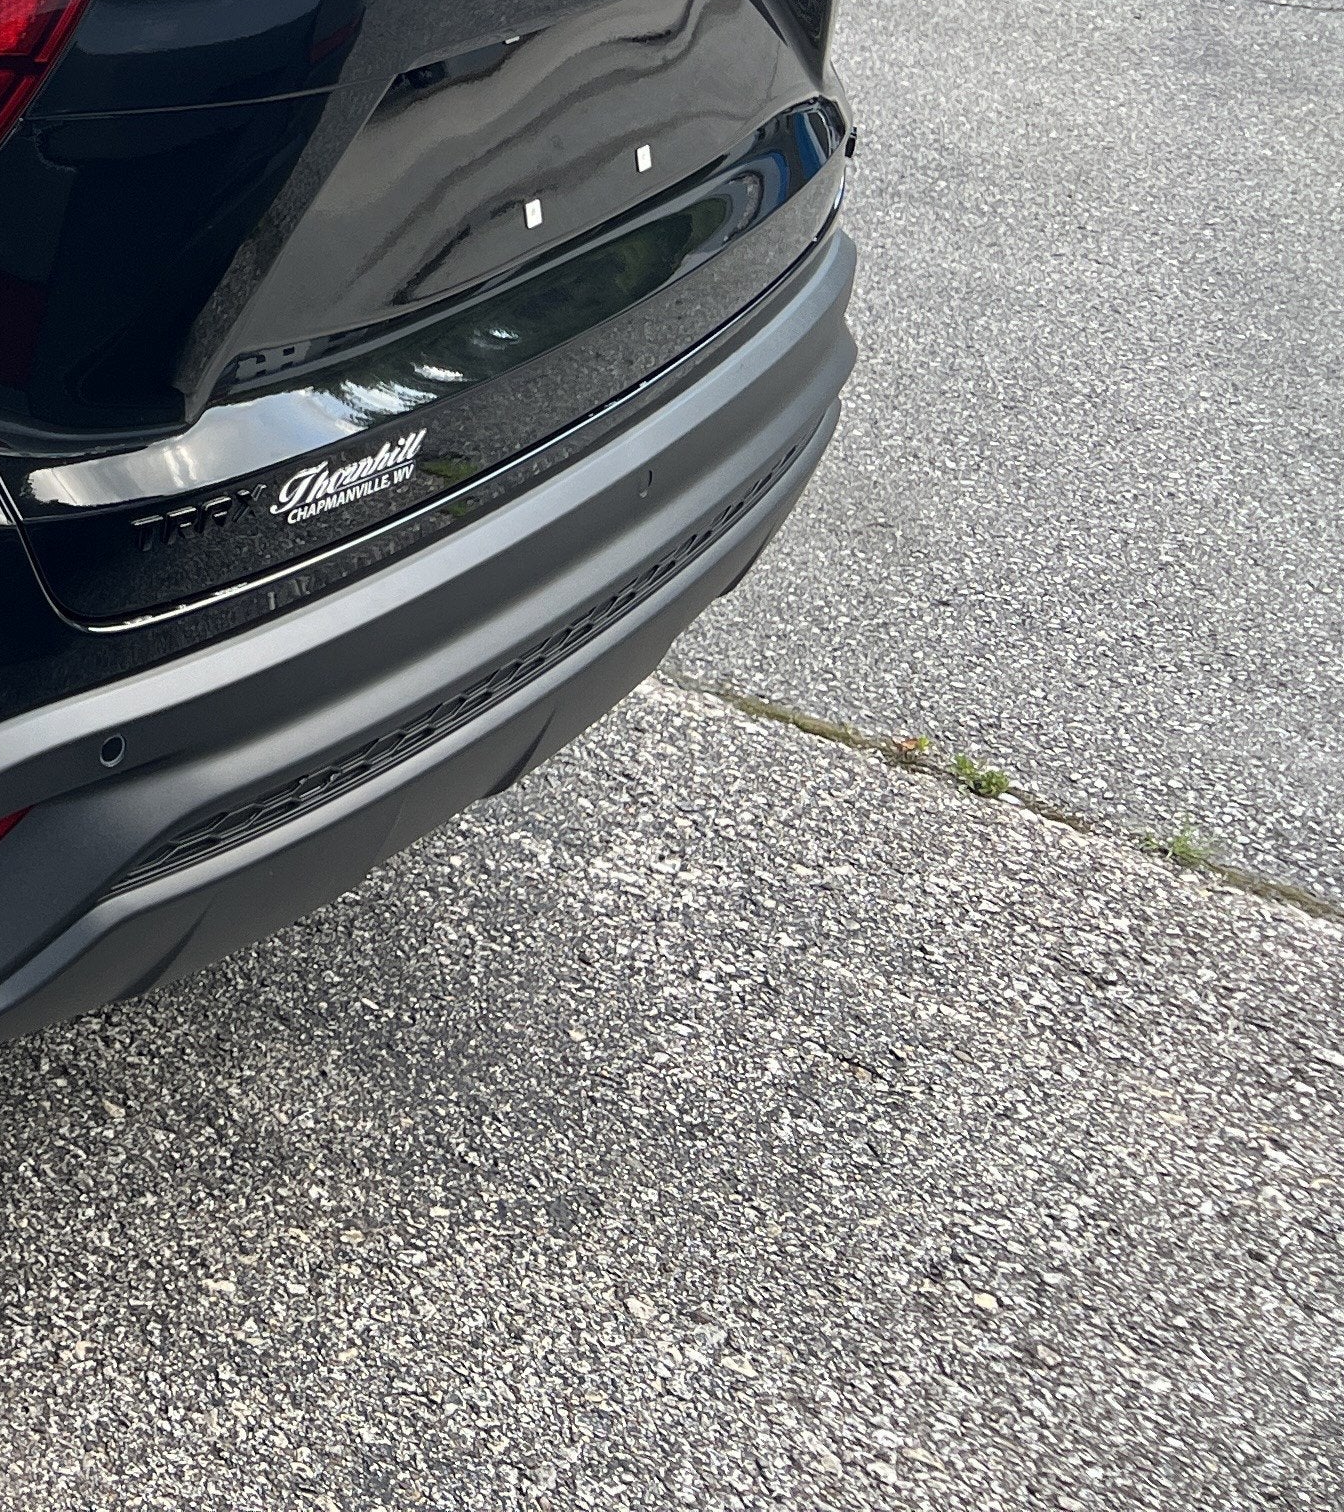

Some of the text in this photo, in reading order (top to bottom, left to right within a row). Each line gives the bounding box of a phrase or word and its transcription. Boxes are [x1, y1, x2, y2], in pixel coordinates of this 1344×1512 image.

[269, 427, 428, 515] Thornhill
[392, 463, 415, 486] WV
[130, 483, 268, 552] TRAX
